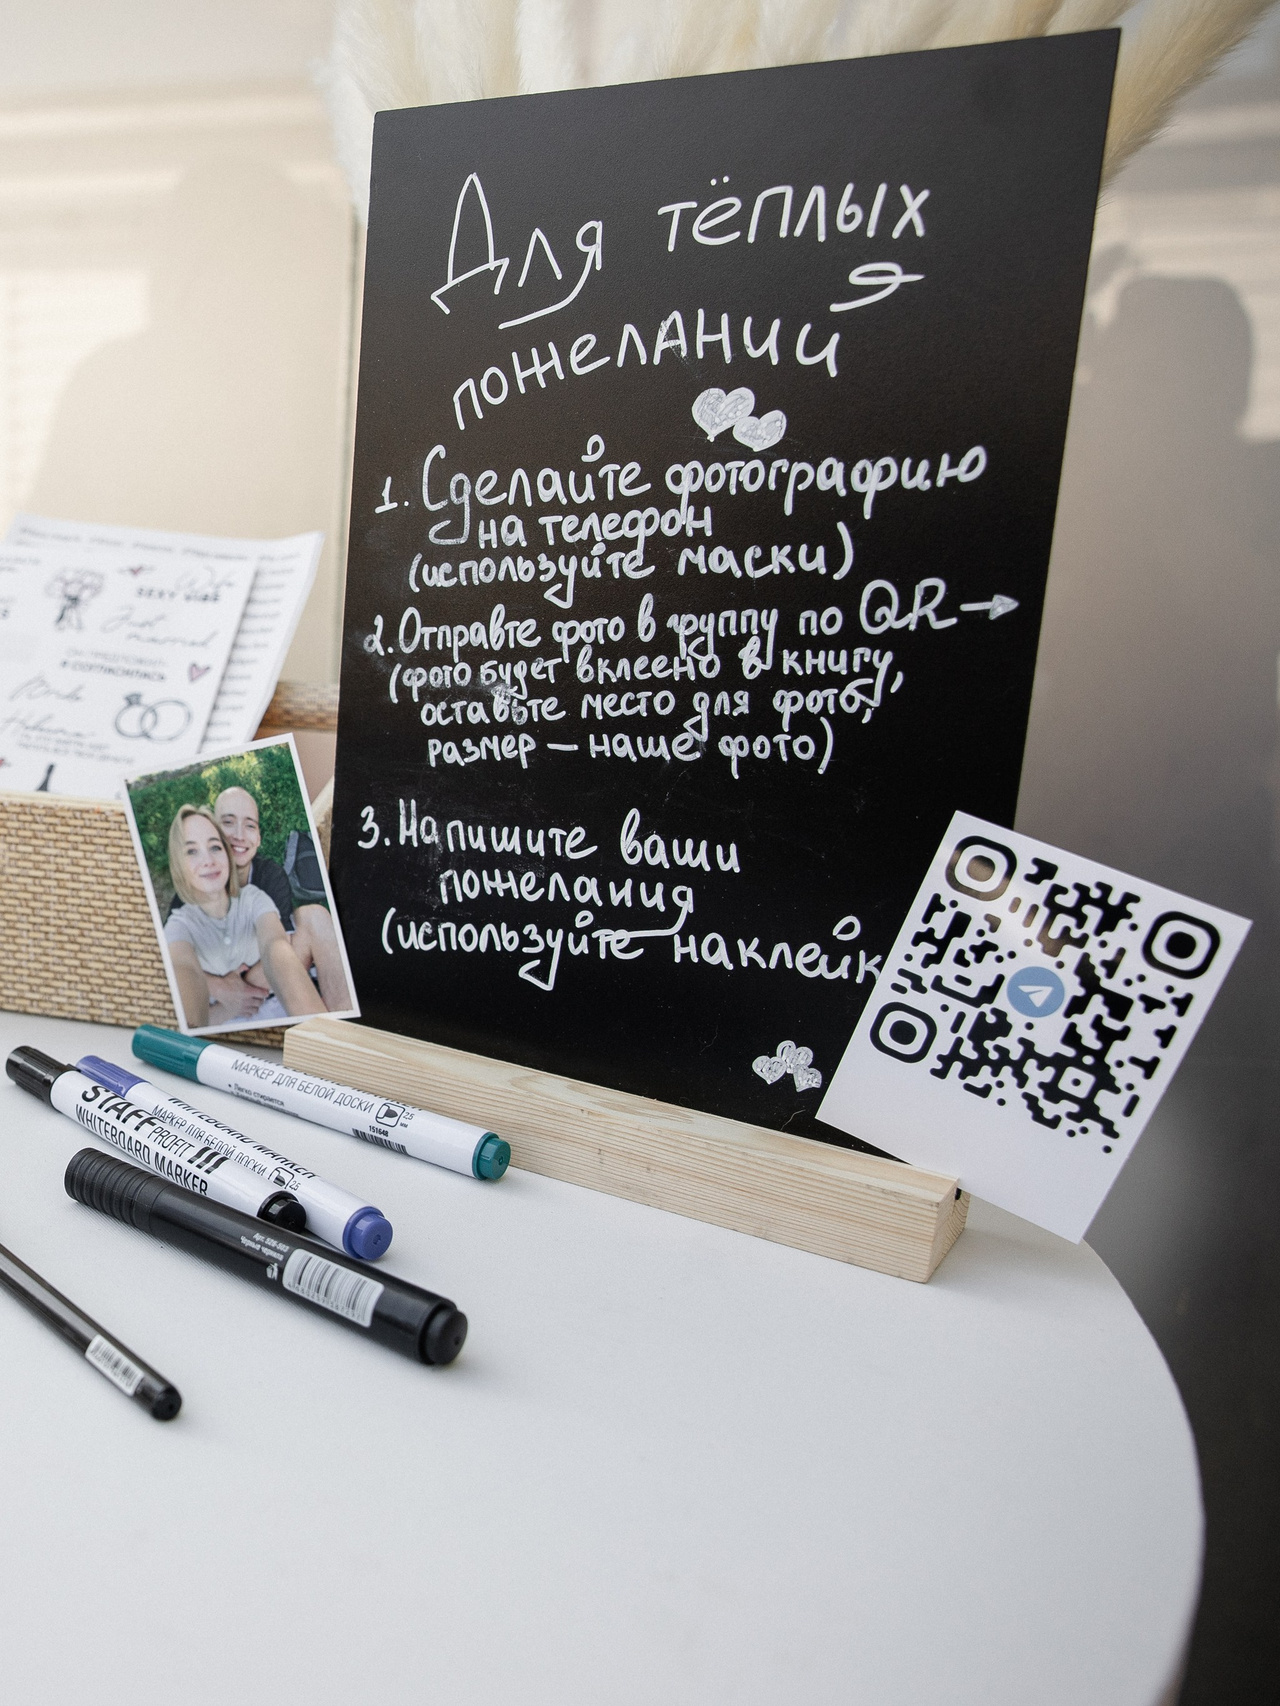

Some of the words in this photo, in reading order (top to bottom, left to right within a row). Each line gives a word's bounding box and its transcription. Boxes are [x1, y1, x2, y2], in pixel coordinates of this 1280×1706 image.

[431, 173, 603, 328] Для
[658, 176, 929, 251] тёплых
[453, 262, 925, 430] пожеланий
[375, 476, 409, 513] 1.
[422, 434, 651, 544] Сделайте
[665, 445, 987, 524] фотографию
[409, 542, 655, 609] (используйте
[677, 521, 853, 580] маски)
[478, 515, 527, 548] на
[538, 505, 712, 566] телефон
[551, 616, 625, 663] фото
[638, 592, 656, 643] в
[666, 608, 778, 664] группу
[799, 606, 843, 635] по
[859, 577, 958, 635] QR
[389, 662, 472, 704] (фото
[480, 656, 563, 700] будет
[576, 643, 721, 684] вклеено
[738, 635, 762, 680] в
[783, 646, 904, 708] книгу,
[420, 692, 567, 726] оставьте
[581, 689, 676, 720] место
[683, 691, 749, 742] для
[427, 733, 536, 769] размер
[589, 733, 701, 762] наше
[718, 716, 833, 779] фото)
[358, 805, 390, 849] 3.
[399, 798, 598, 860] Напишите
[620, 808, 740, 873] ваши
[439, 868, 694, 935] пожелания
[381, 907, 644, 991] (используйте
[674, 915, 882, 984] наклейк
[81, 1085, 167, 1131] STAFF
[150, 1126, 195, 1158] PROFIT
[231, 1059, 275, 1081] МАРКЕР
[272, 1074, 298, 1089] ДЛЯ
[297, 1080, 336, 1102] БЕЛОЙ
[333, 1092, 375, 1114] ДОСКИ
[76, 1104, 151, 1165] WHITEBOARD
[153, 1151, 209, 1196] MARKER
